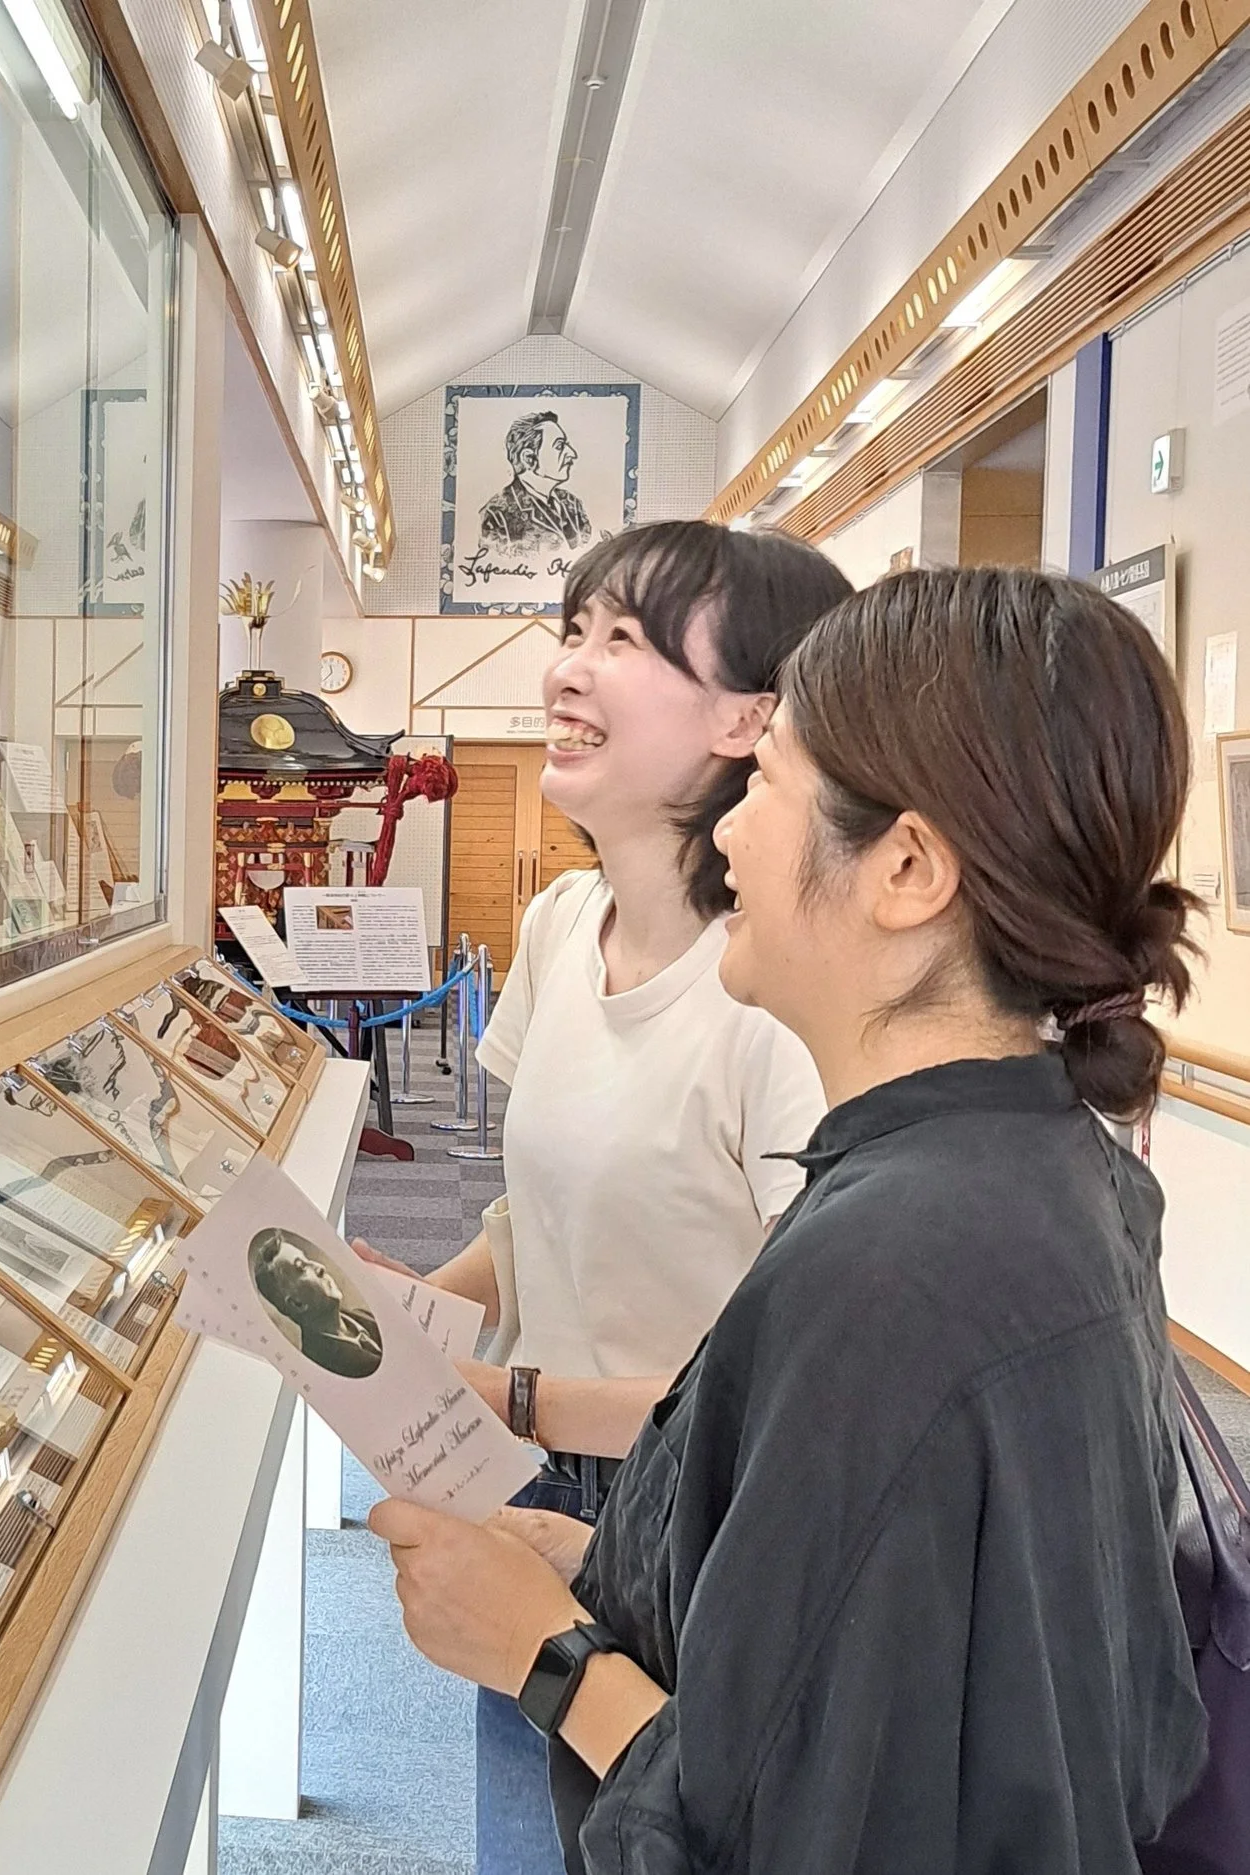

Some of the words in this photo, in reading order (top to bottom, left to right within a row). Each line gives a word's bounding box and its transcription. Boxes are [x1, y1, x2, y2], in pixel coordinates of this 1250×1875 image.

[458, 547, 538, 588] Lafcadio
[509, 716, 545, 728] 多目的
[373, 1446, 405, 1477] Yaizu
[401, 1411, 440, 1448] Lafcadio
[434, 1386, 467, 1415] Hearn
[402, 1443, 448, 1492] Memorial
